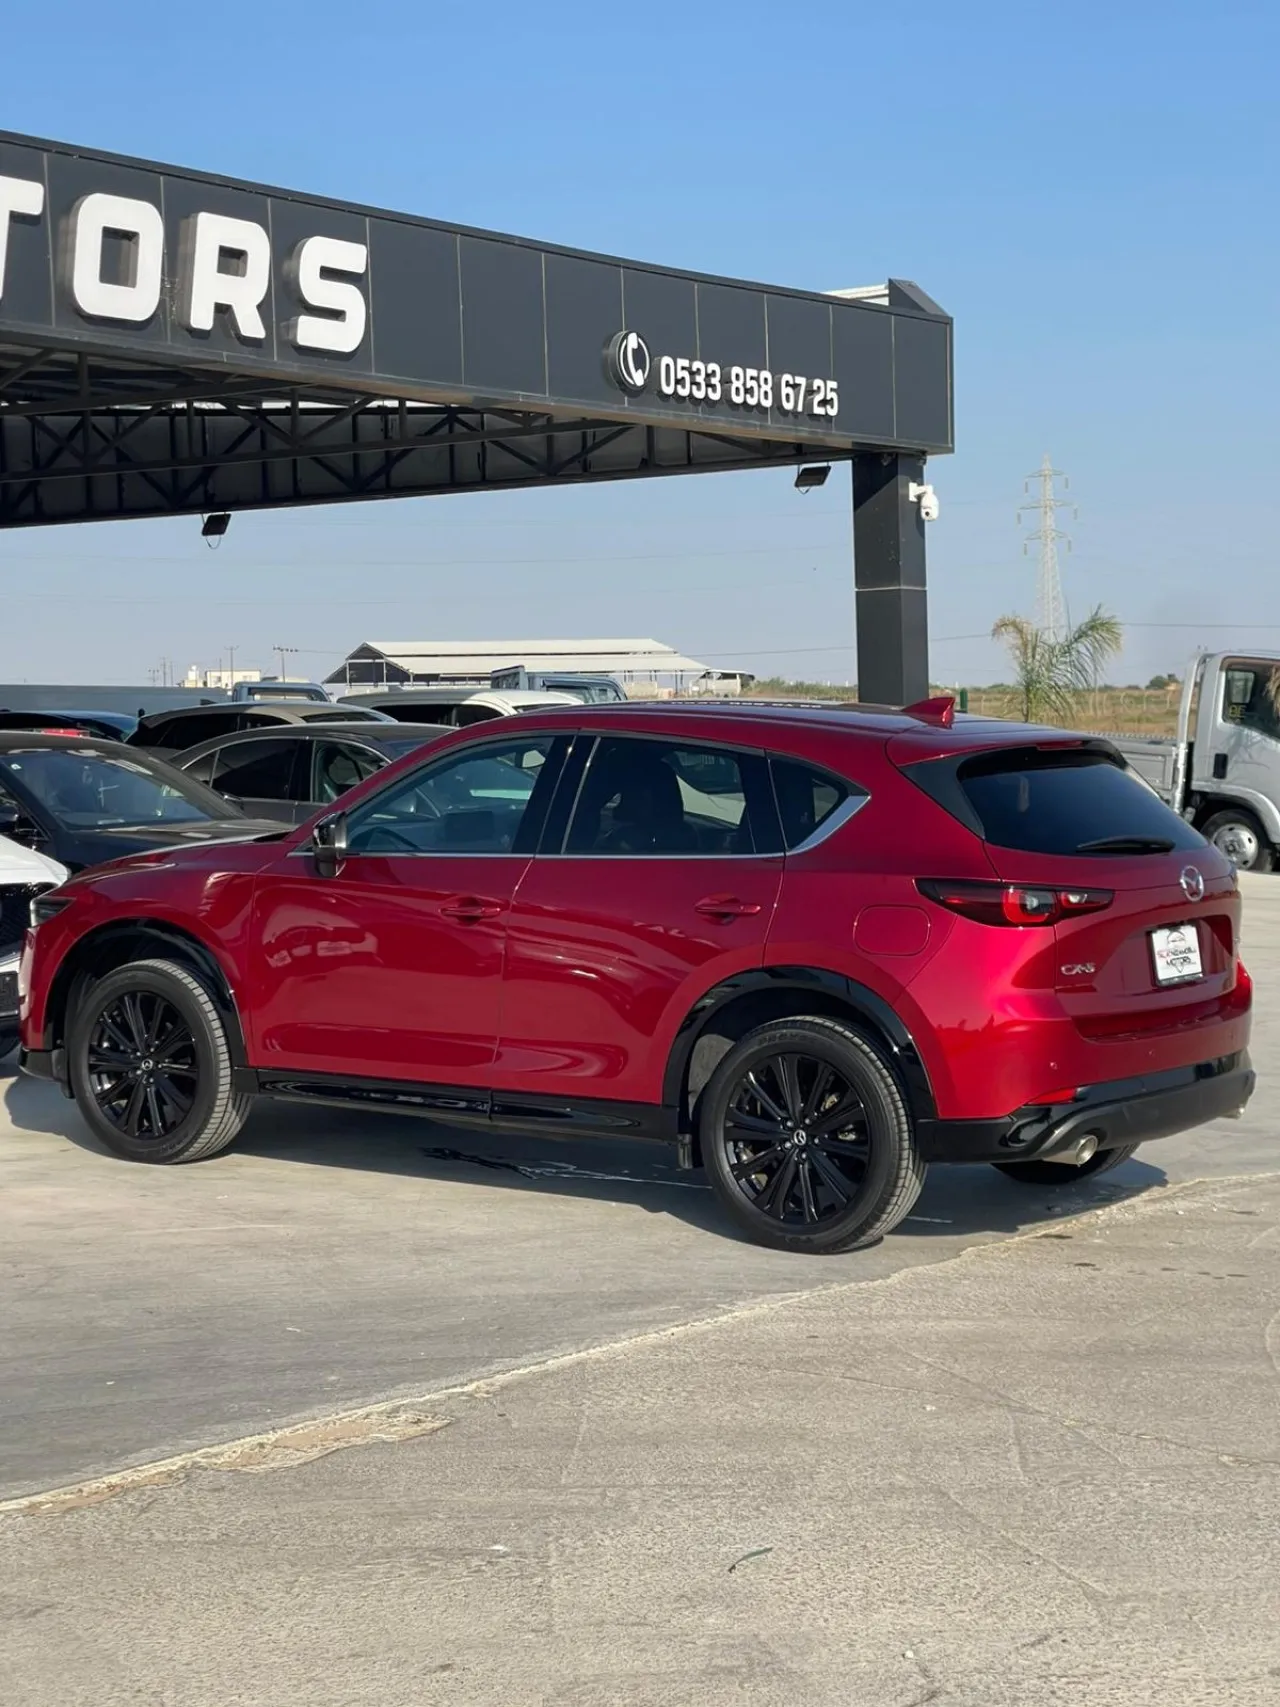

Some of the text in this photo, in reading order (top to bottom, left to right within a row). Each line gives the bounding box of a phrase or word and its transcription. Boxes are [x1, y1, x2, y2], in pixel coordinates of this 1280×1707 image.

[660, 356, 838, 417] 0533 858 67 25
